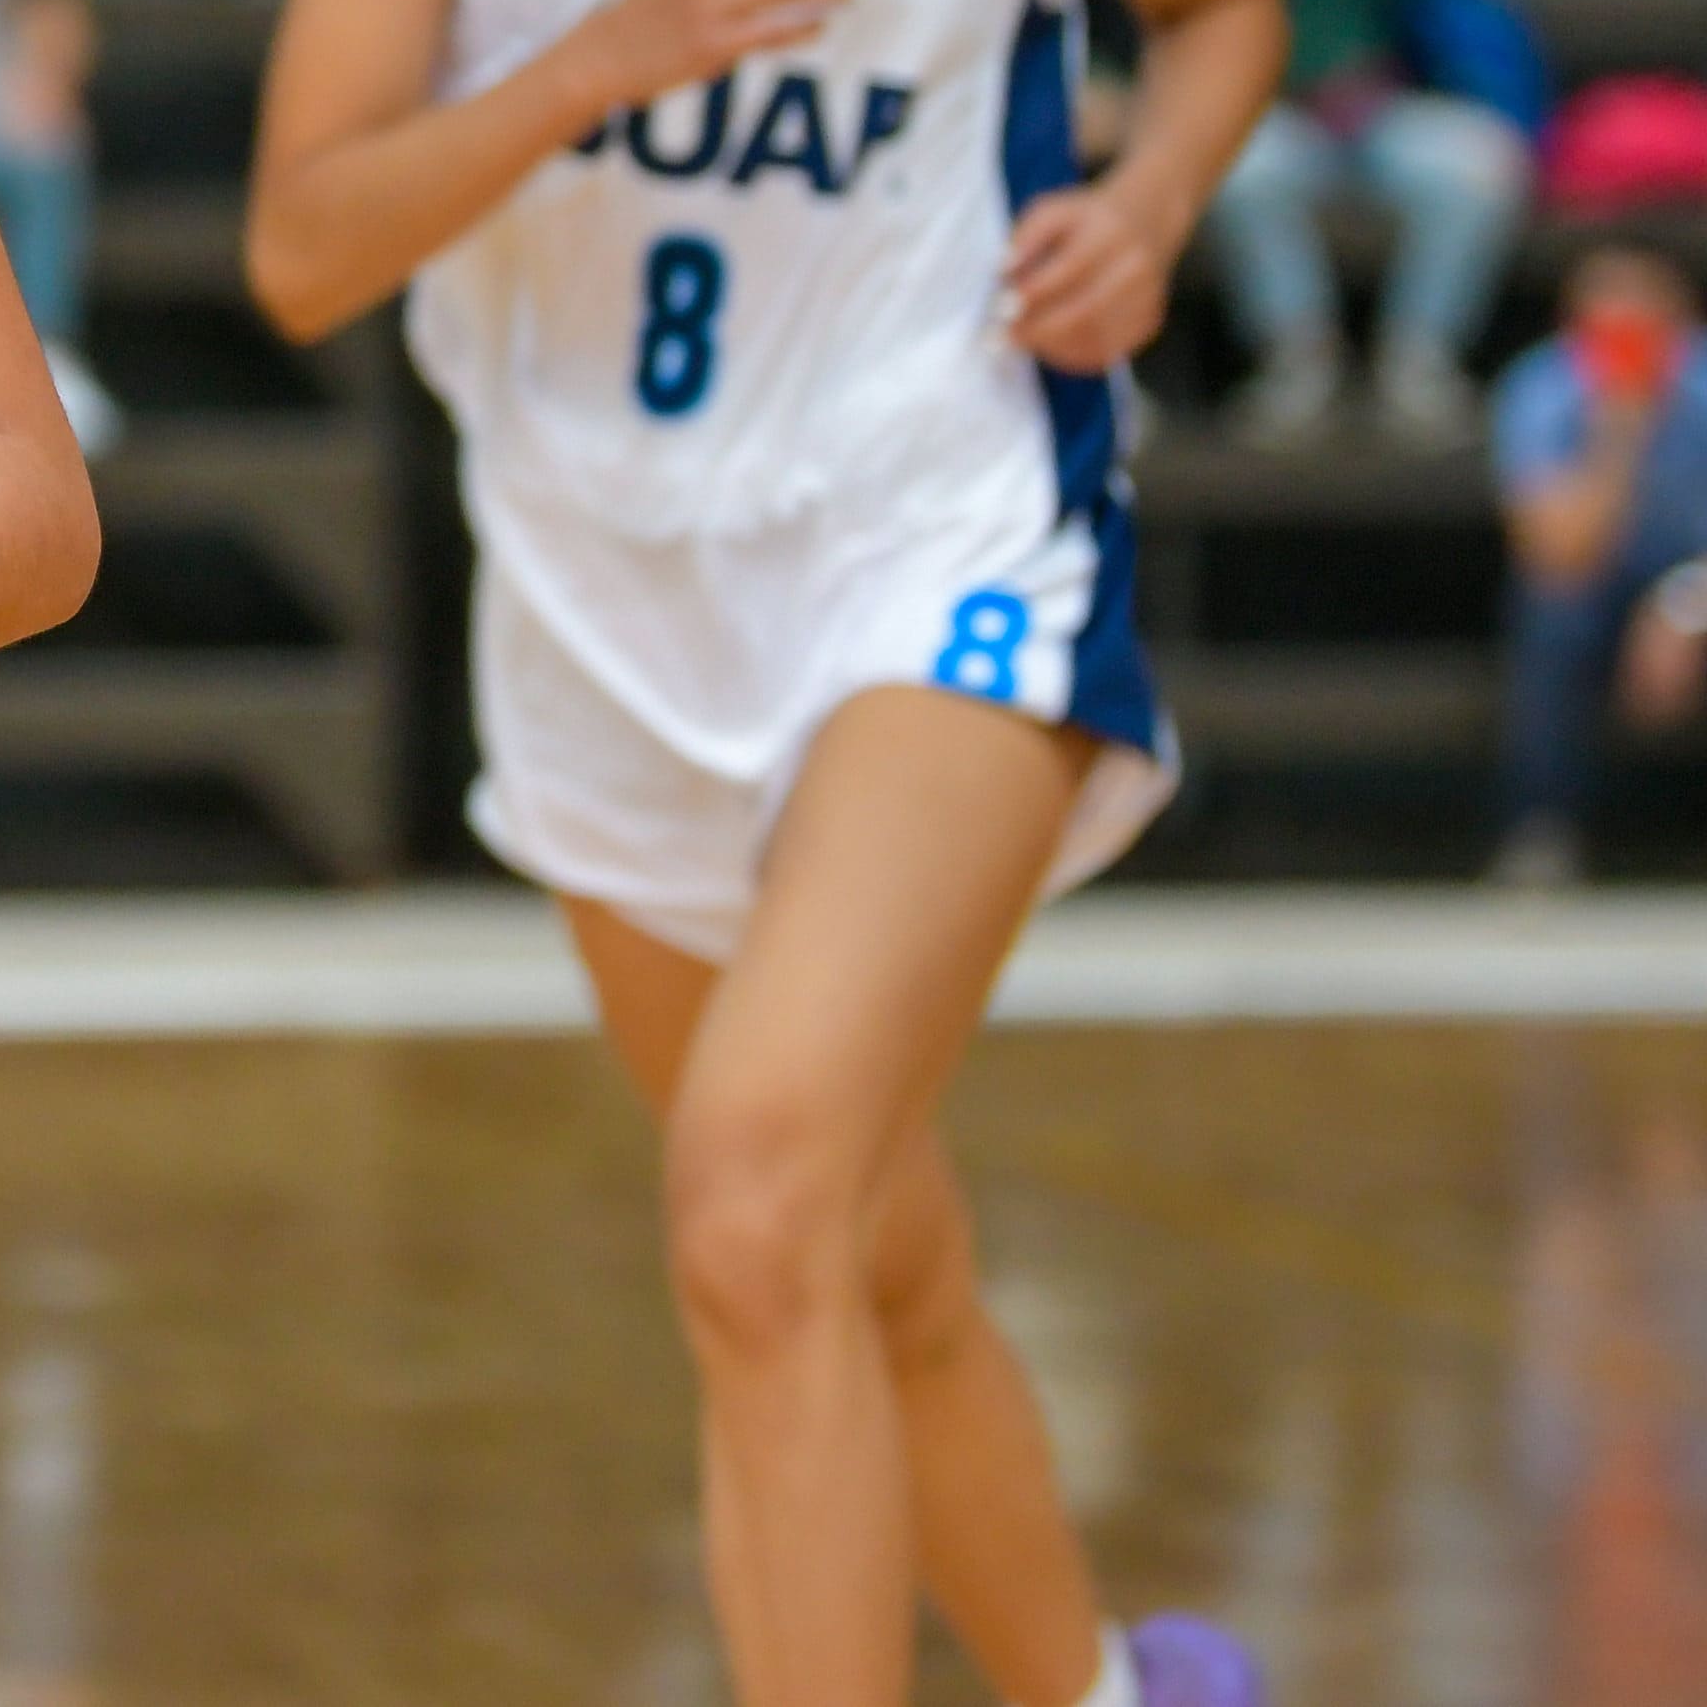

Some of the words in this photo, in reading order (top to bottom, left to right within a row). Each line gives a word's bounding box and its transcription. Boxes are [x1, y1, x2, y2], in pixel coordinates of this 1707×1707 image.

[567, 67, 917, 195] UAP
[636, 229, 725, 417] 8
[929, 589, 1031, 701] 8
